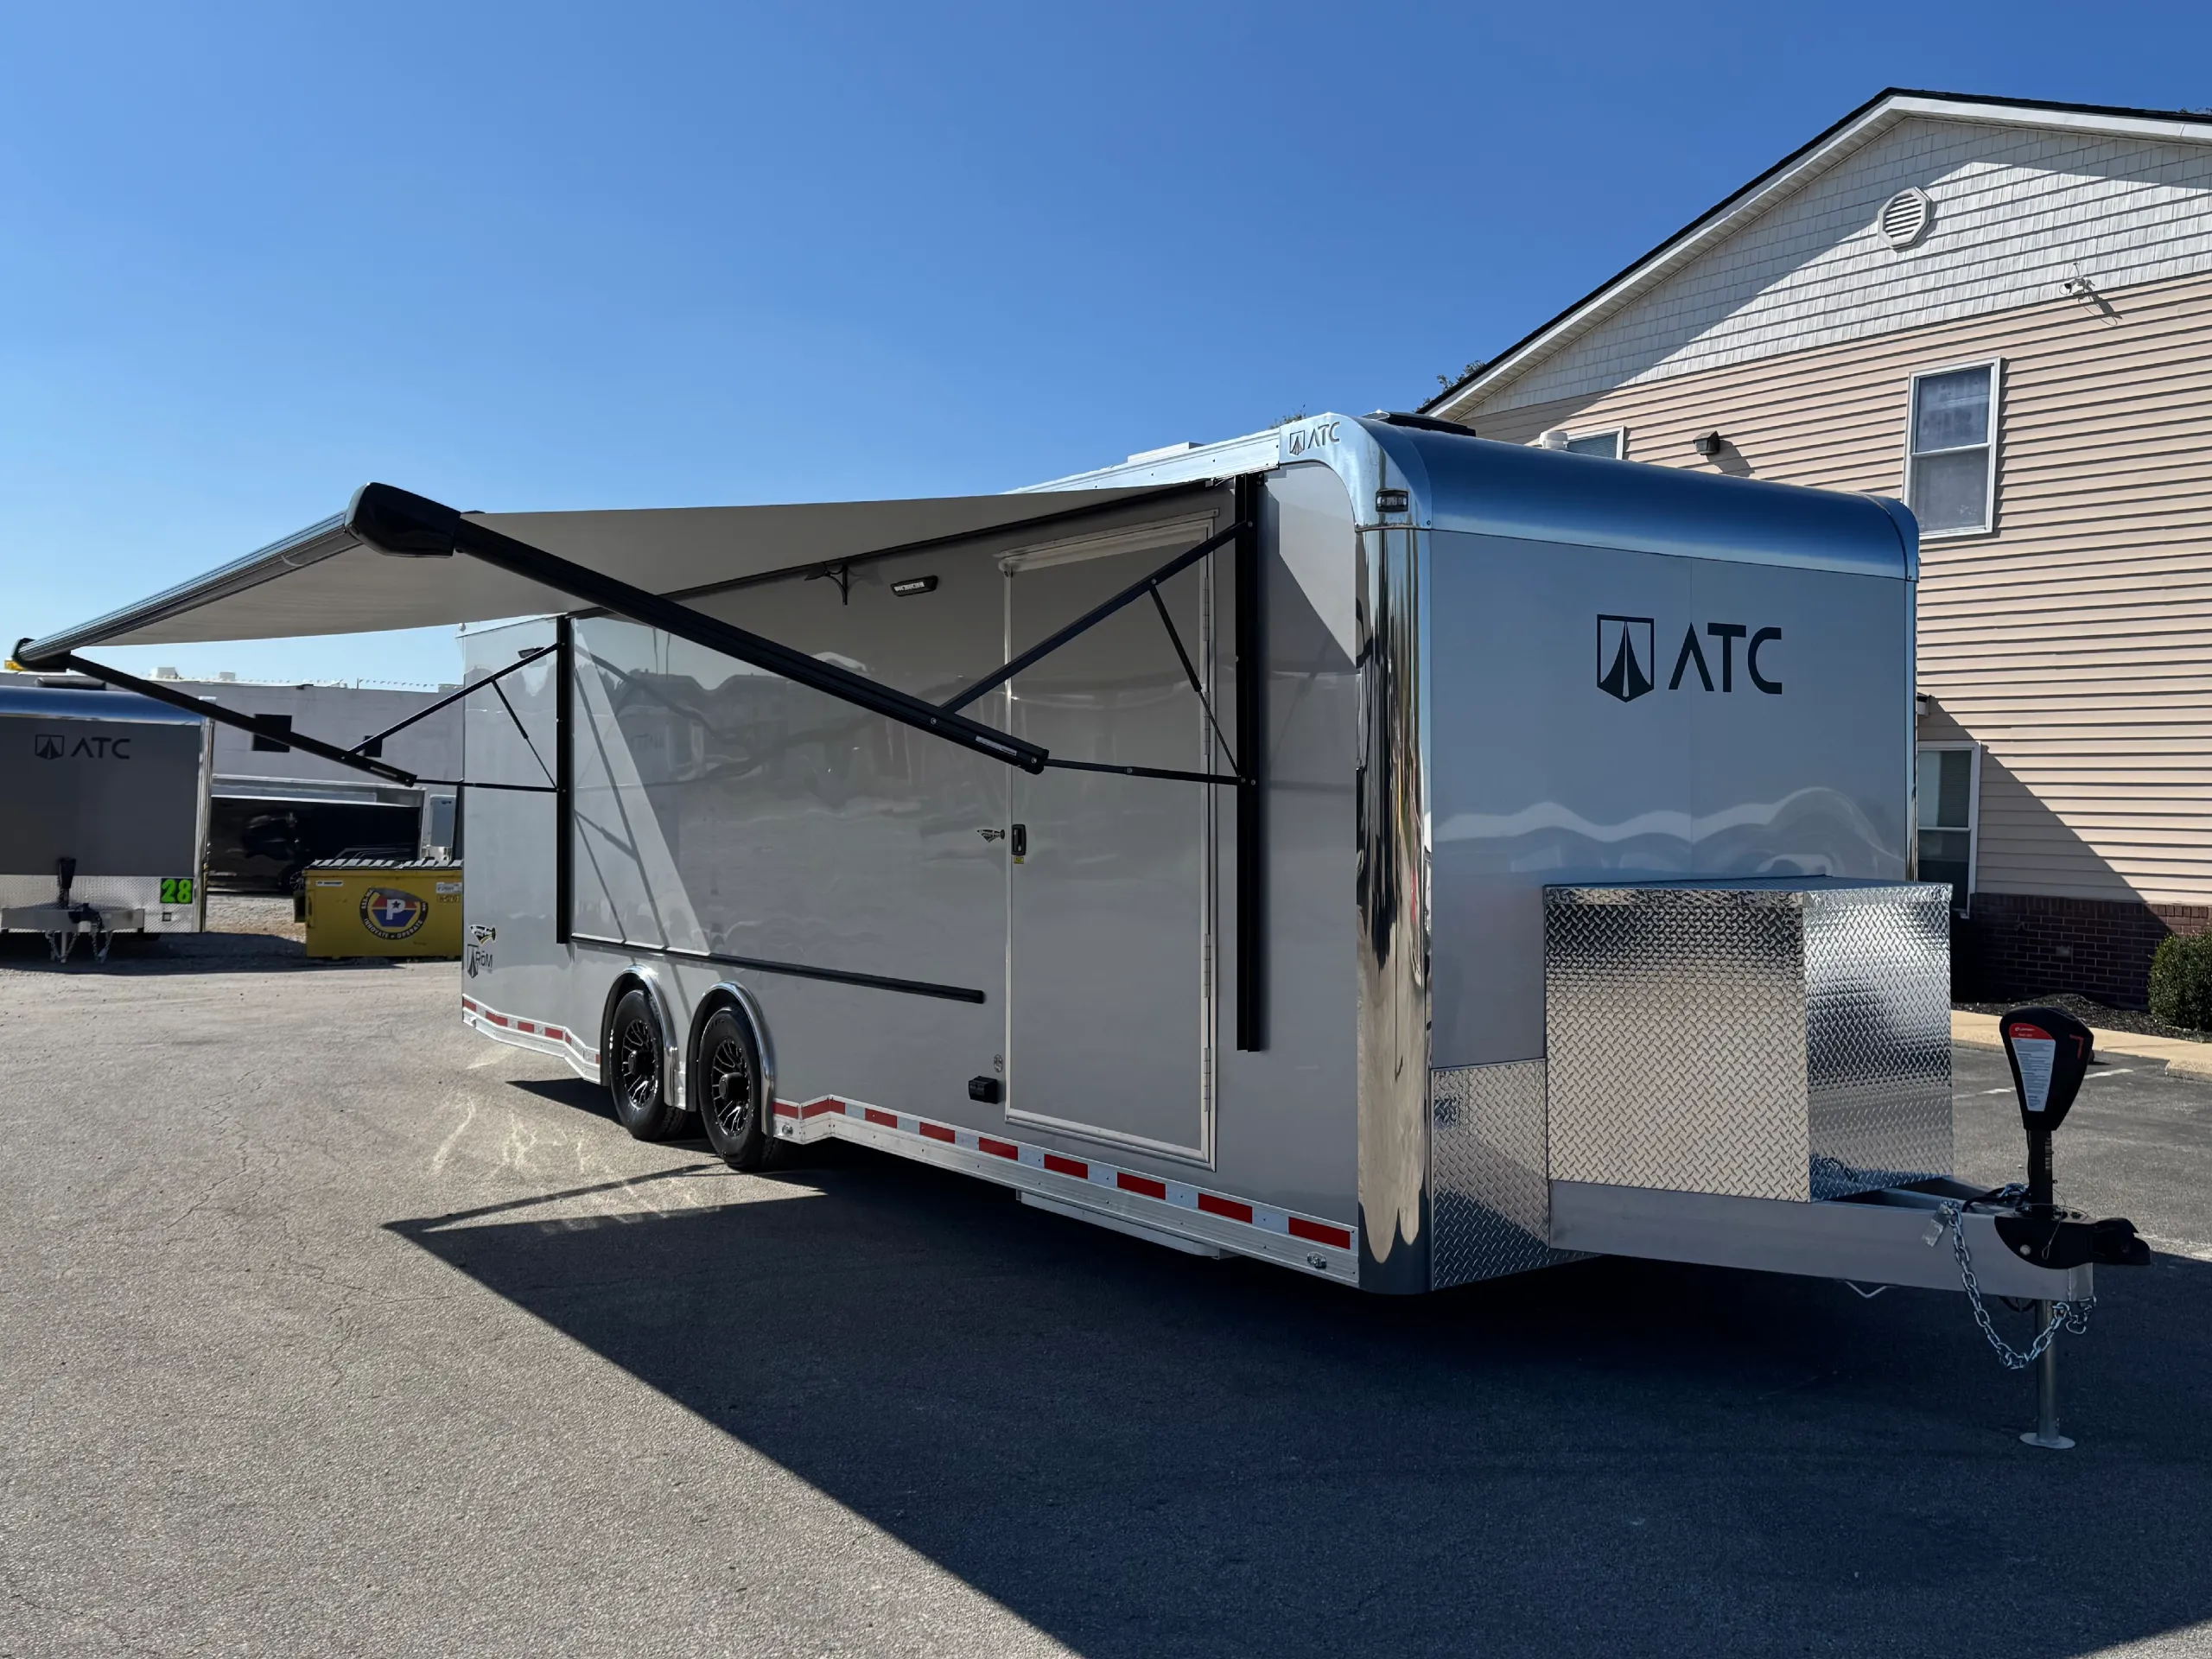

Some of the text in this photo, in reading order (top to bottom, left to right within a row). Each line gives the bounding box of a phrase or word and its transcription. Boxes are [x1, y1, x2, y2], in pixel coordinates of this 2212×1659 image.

[1307, 421, 1340, 449] ATC
[1668, 621, 1783, 696] ATC
[70, 736, 131, 760] ATC
[161, 878, 193, 904] 28
[385, 899, 406, 920] P
[363, 918, 423, 939] INNOVATE OPERATE
